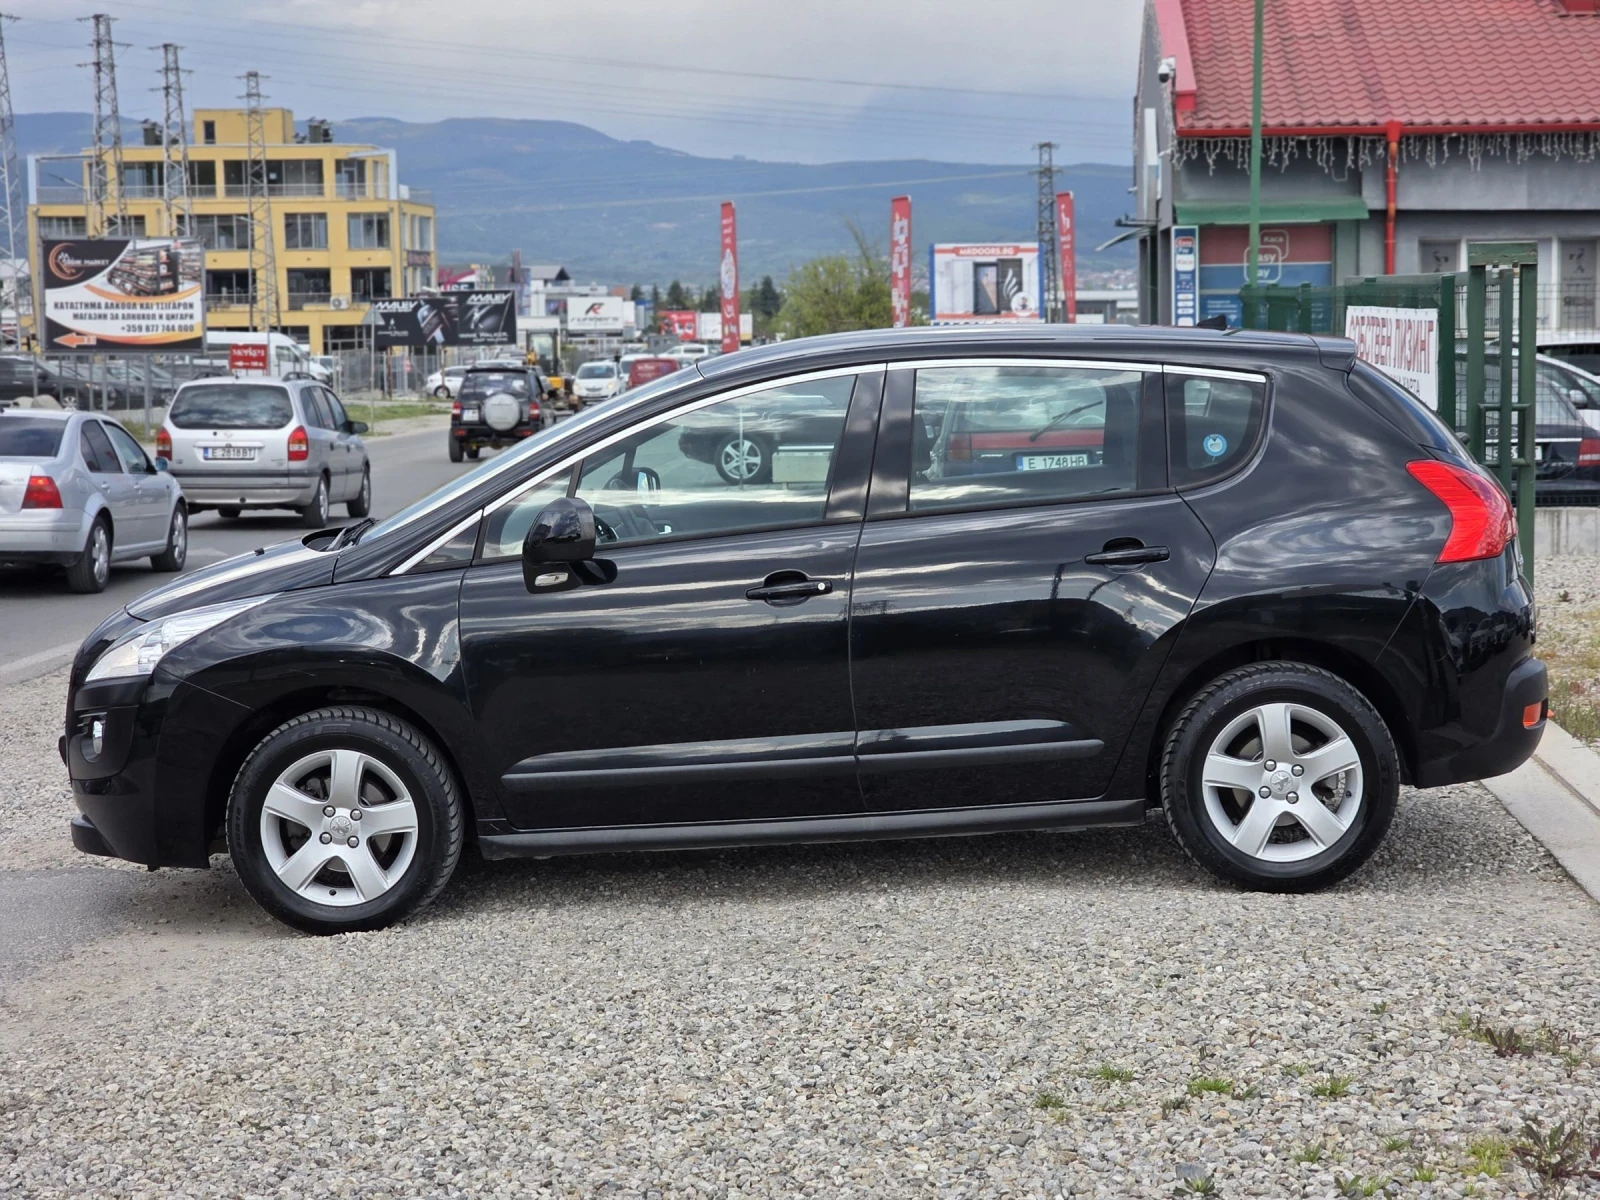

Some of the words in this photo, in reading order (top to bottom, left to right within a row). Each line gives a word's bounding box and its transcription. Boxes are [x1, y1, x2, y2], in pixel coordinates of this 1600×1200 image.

[959, 246, 1014, 255] MRDOORS.BG
[1257, 253, 1276, 263] asy
[72, 313, 108, 321] МАГАЗИН
[165, 313, 194, 322] ЦИГАРИ
[121, 324, 143, 333] +359
[145, 324, 159, 333] 877
[1392, 318, 1434, 374] ЛИЗИНГ
[1028, 457, 1036, 469] E
